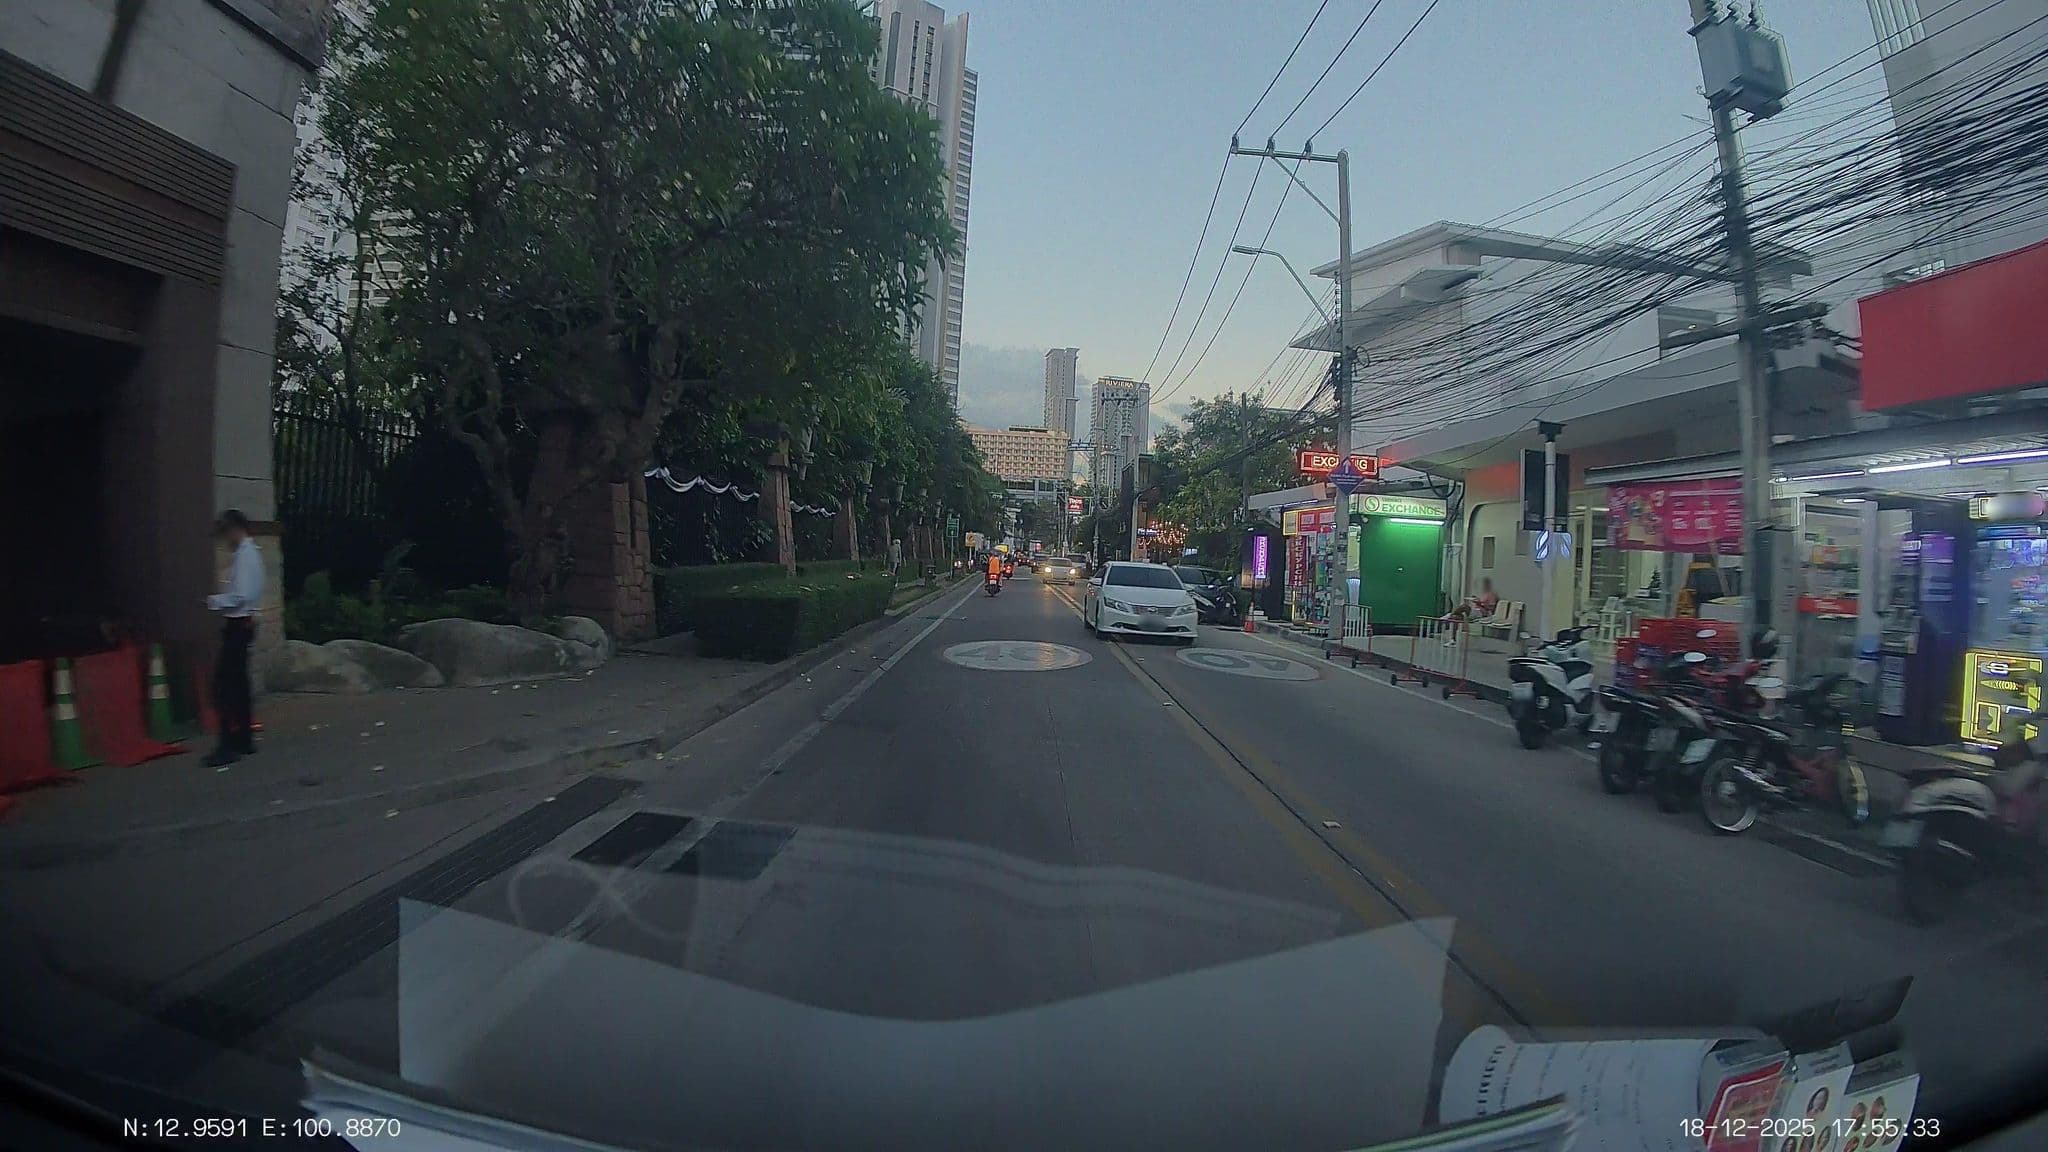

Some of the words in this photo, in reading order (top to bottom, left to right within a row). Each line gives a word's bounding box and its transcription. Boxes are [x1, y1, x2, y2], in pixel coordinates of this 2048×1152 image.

[1105, 379, 1134, 388] RIVIERA
[1381, 503, 1441, 516] EXCHANGE
[954, 646, 1063, 662] 40
